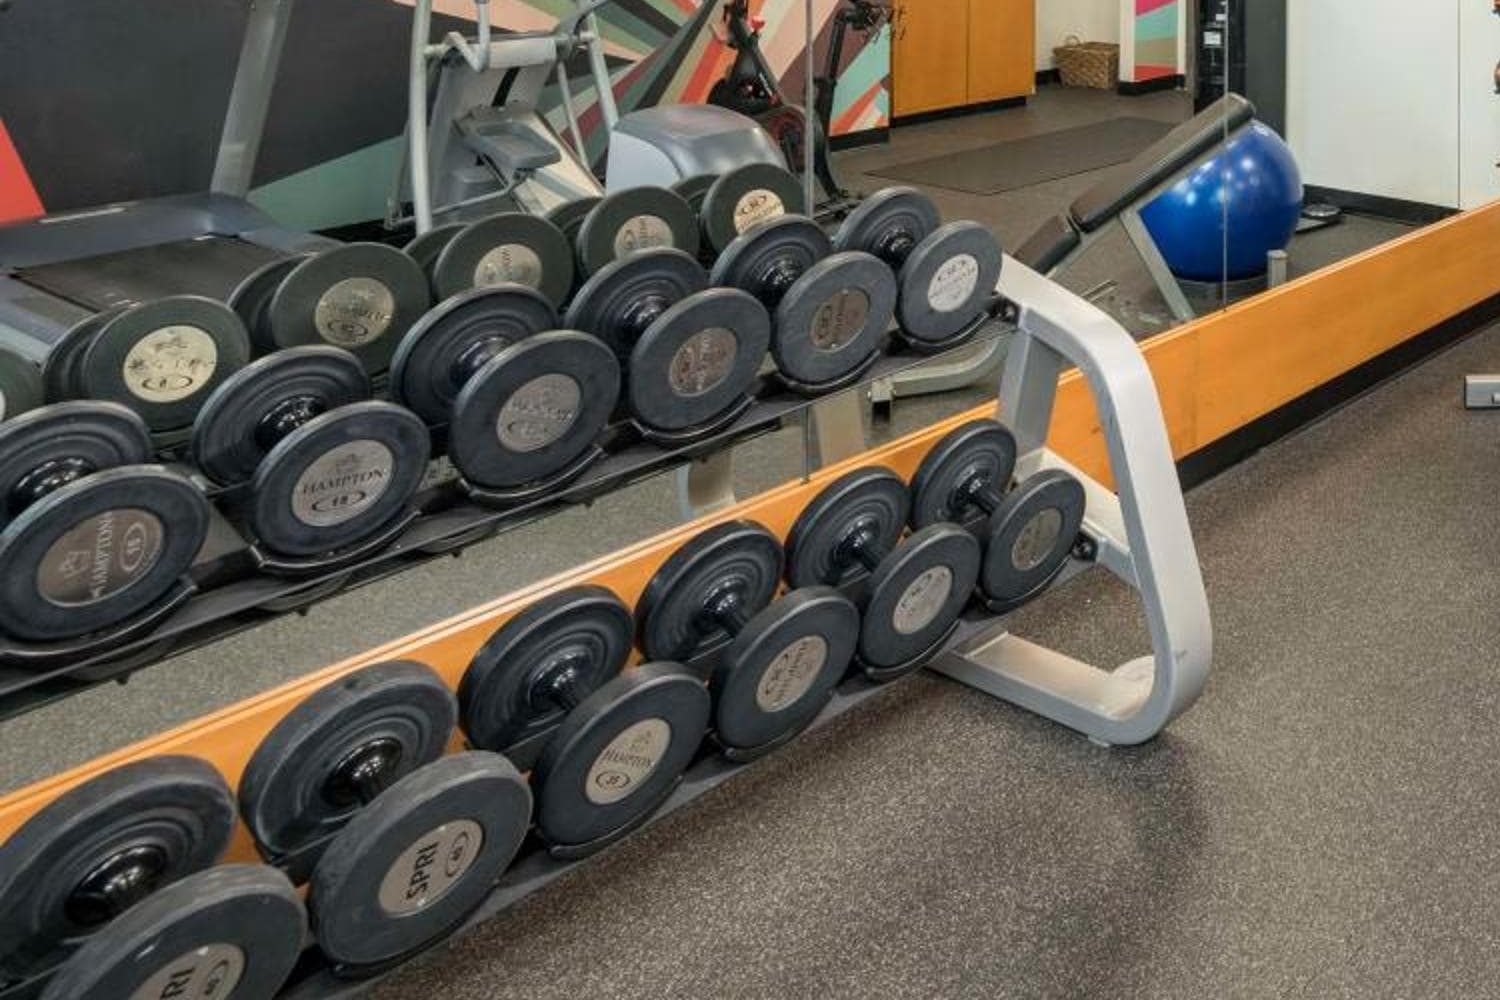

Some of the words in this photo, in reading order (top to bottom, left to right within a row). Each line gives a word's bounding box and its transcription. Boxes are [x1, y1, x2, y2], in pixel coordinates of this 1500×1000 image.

[303, 468, 384, 494] HAMPTON
[404, 841, 441, 900] SPRI
[159, 966, 196, 999] RI
